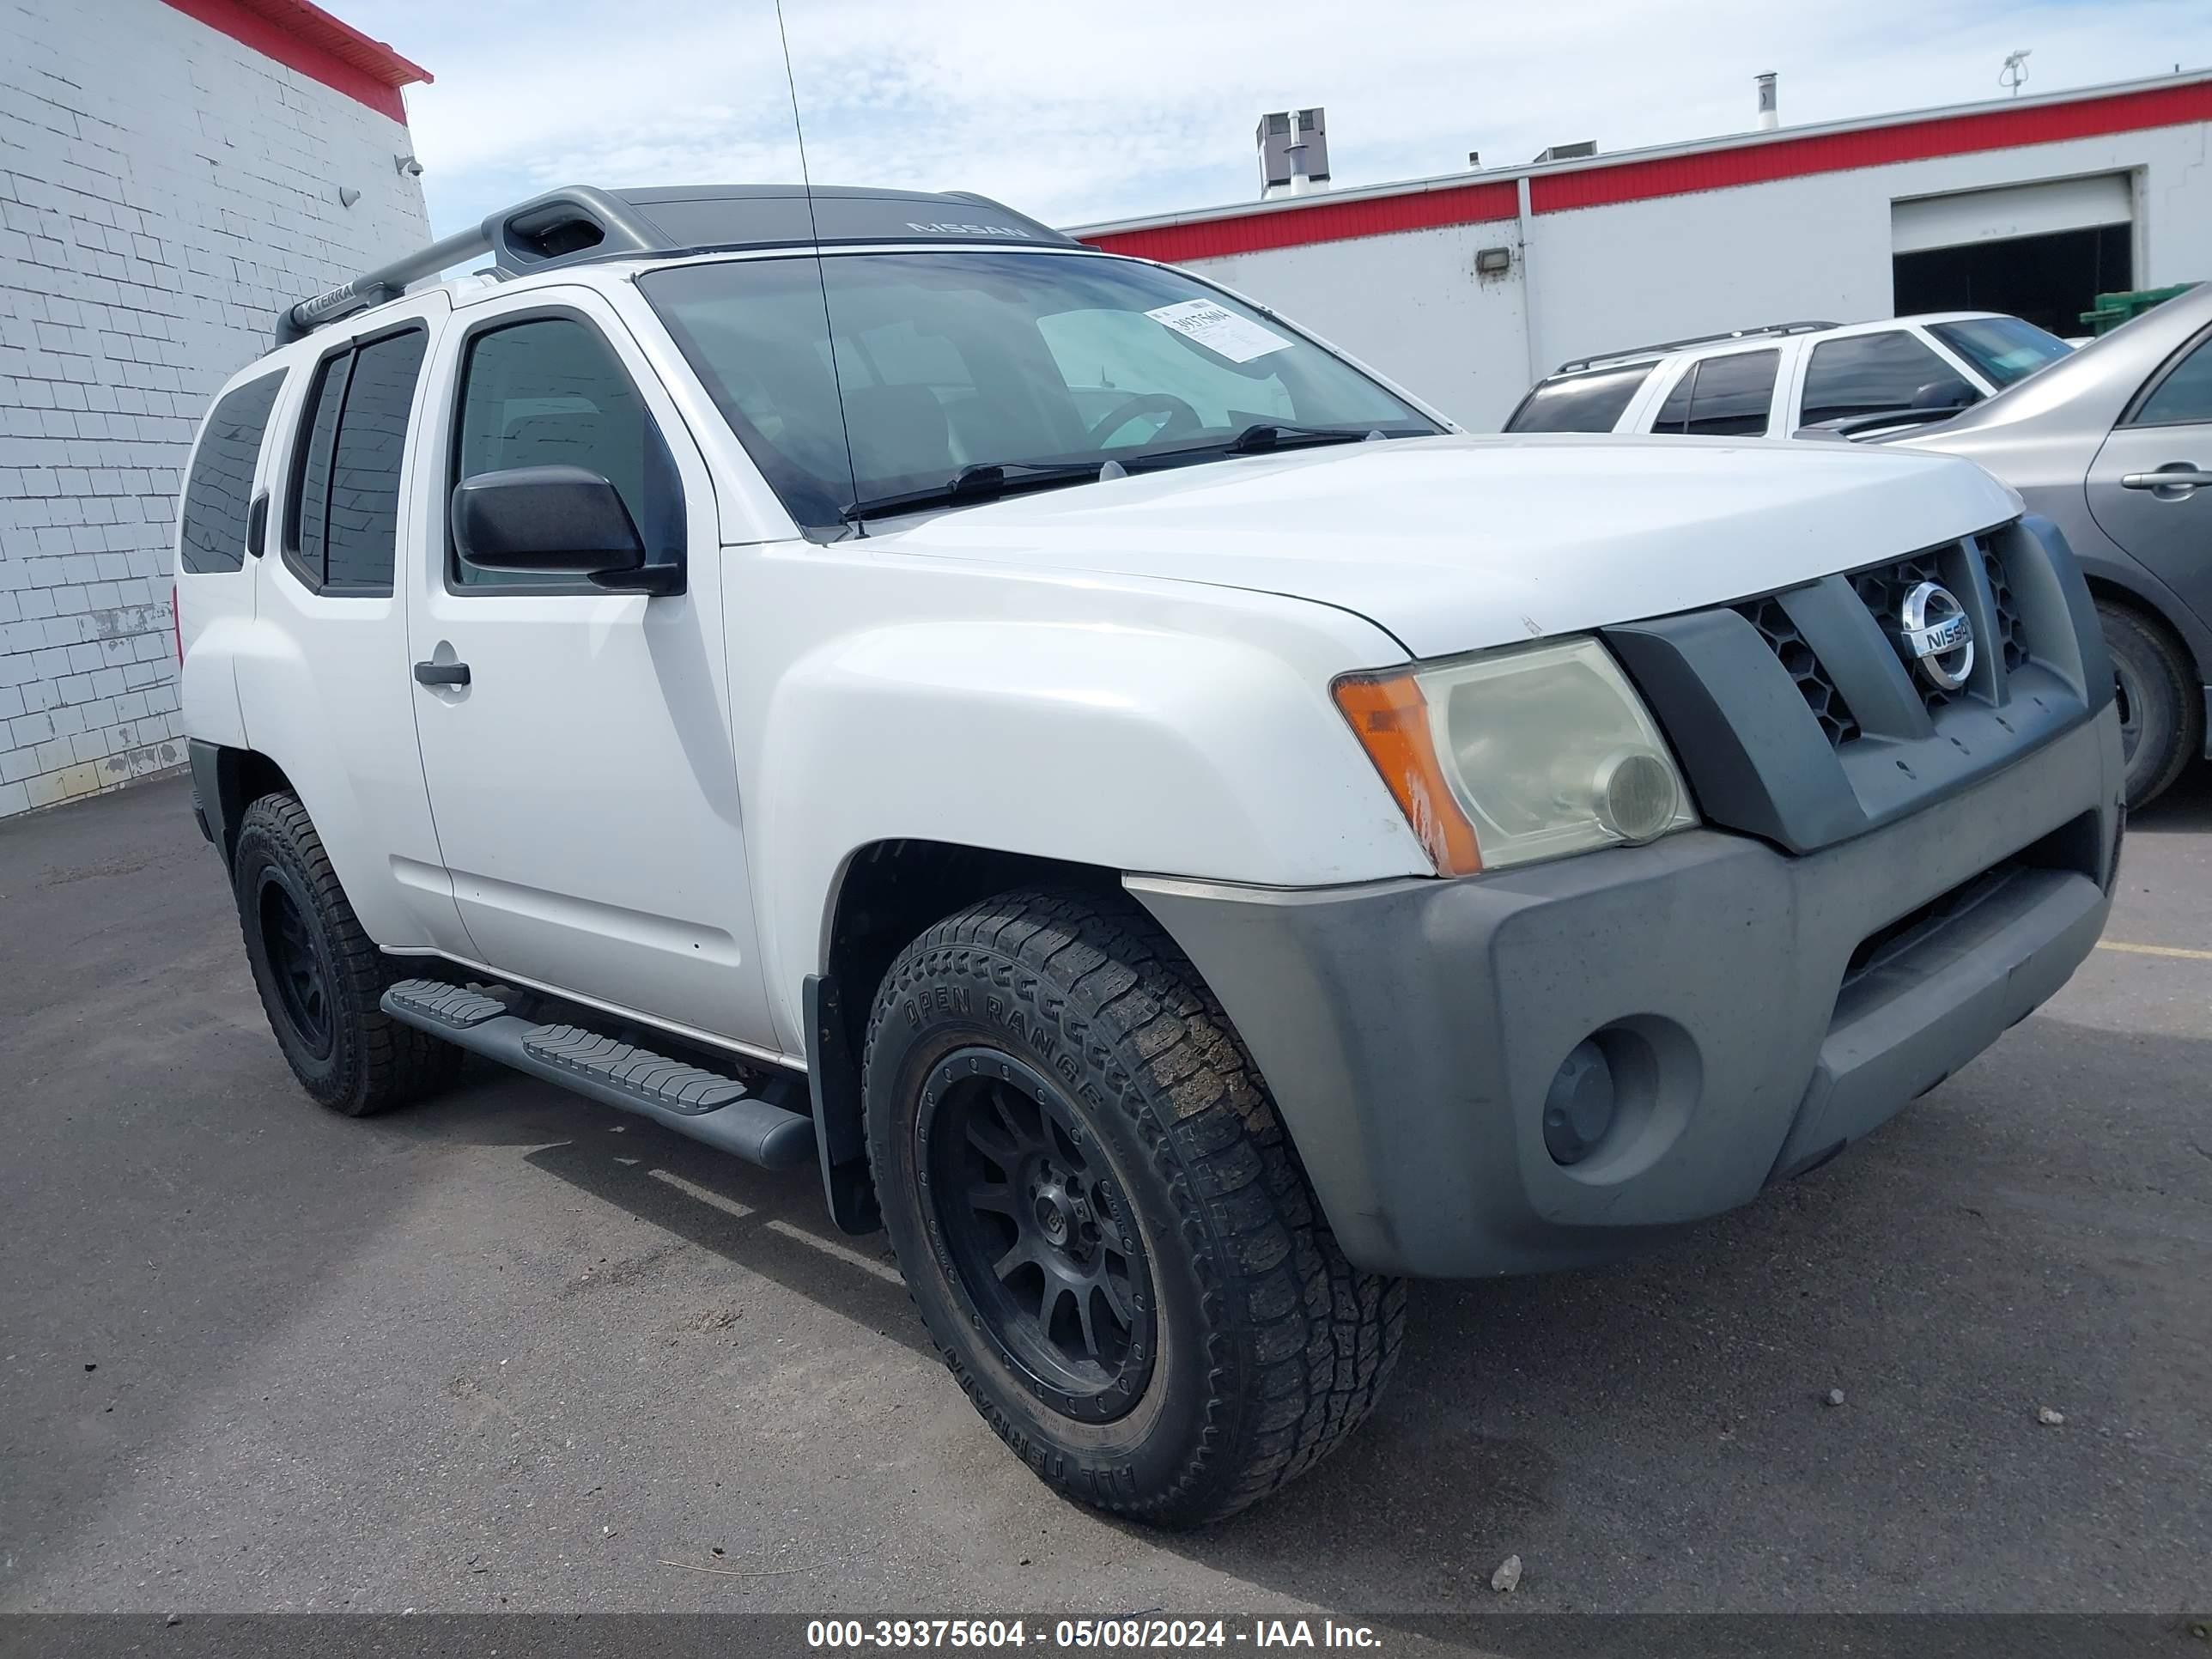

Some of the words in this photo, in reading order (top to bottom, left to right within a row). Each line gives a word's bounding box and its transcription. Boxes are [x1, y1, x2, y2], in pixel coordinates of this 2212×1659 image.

[906, 222, 1030, 237] NISSAN
[301, 282, 356, 320] XTERRA
[1172, 309, 1231, 331] 39375604
[1926, 621, 1972, 649] NISSA
[903, 986, 973, 1026] OPEN
[986, 995, 1103, 1111] RANGE
[1080, 1463, 1136, 1495] ALL
